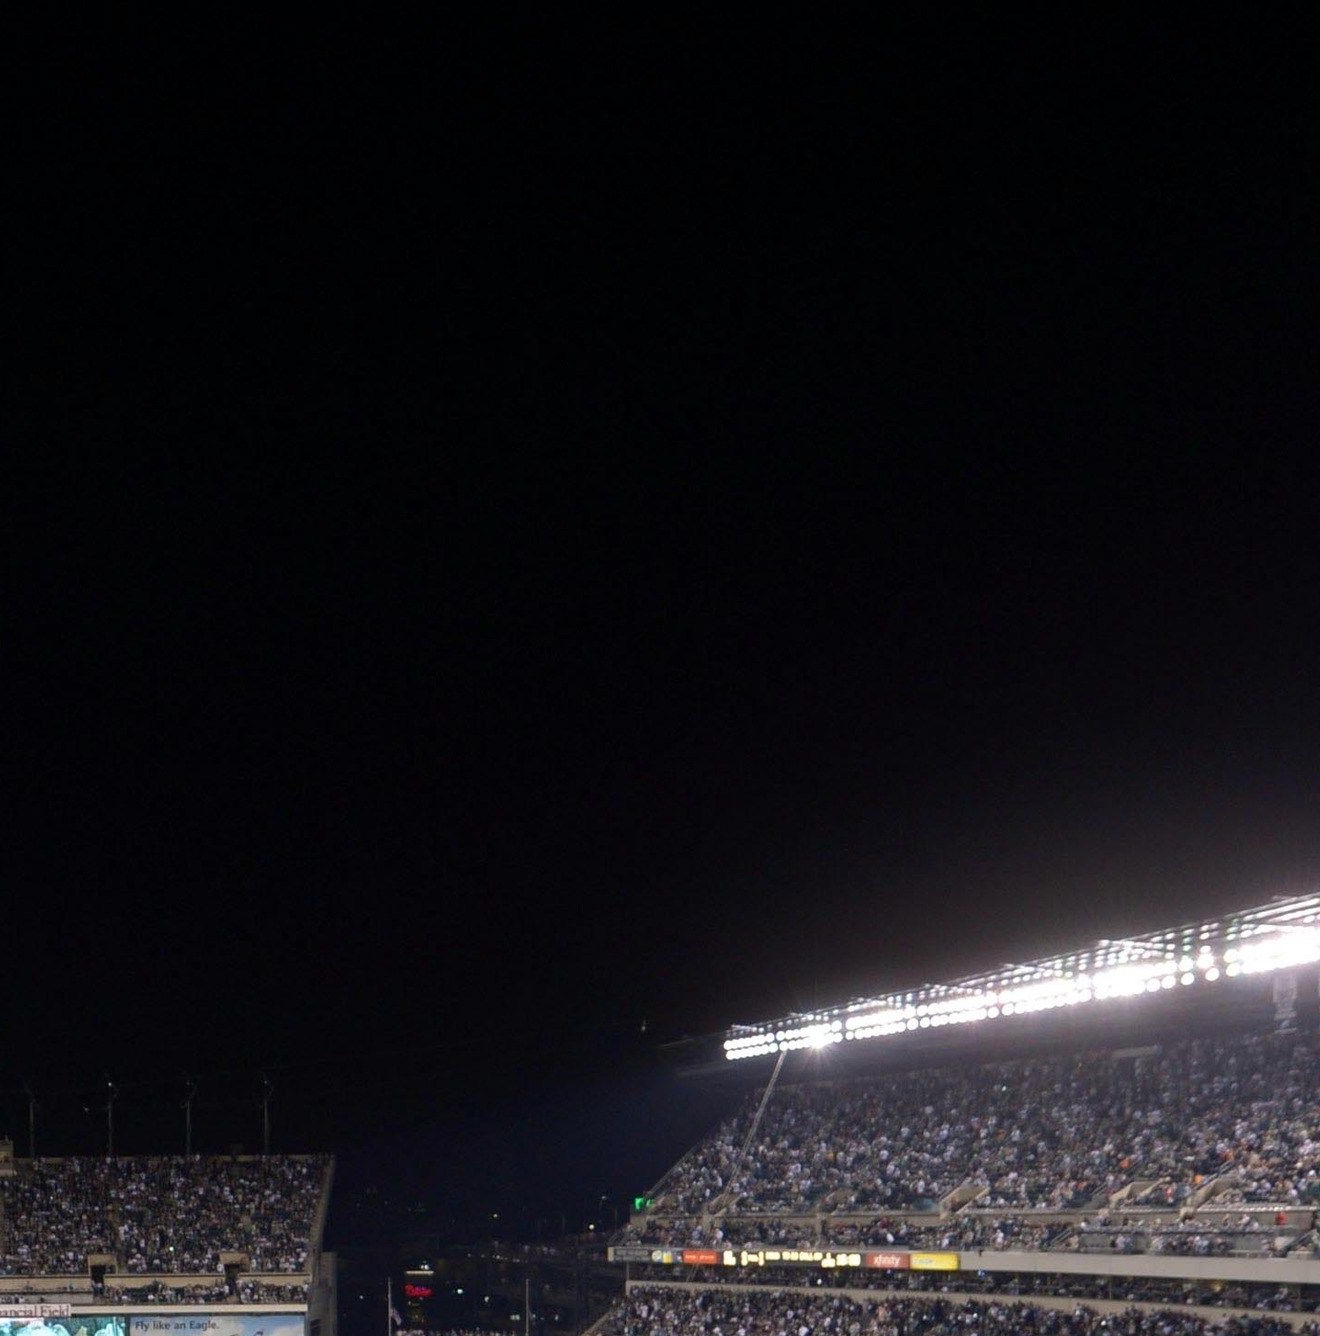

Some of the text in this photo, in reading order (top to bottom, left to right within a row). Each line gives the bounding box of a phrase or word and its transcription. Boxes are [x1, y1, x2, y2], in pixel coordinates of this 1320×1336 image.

[40, 1306, 70, 1318] Field
[135, 1321, 149, 1332] Fly
[153, 1320, 171, 1330] like
